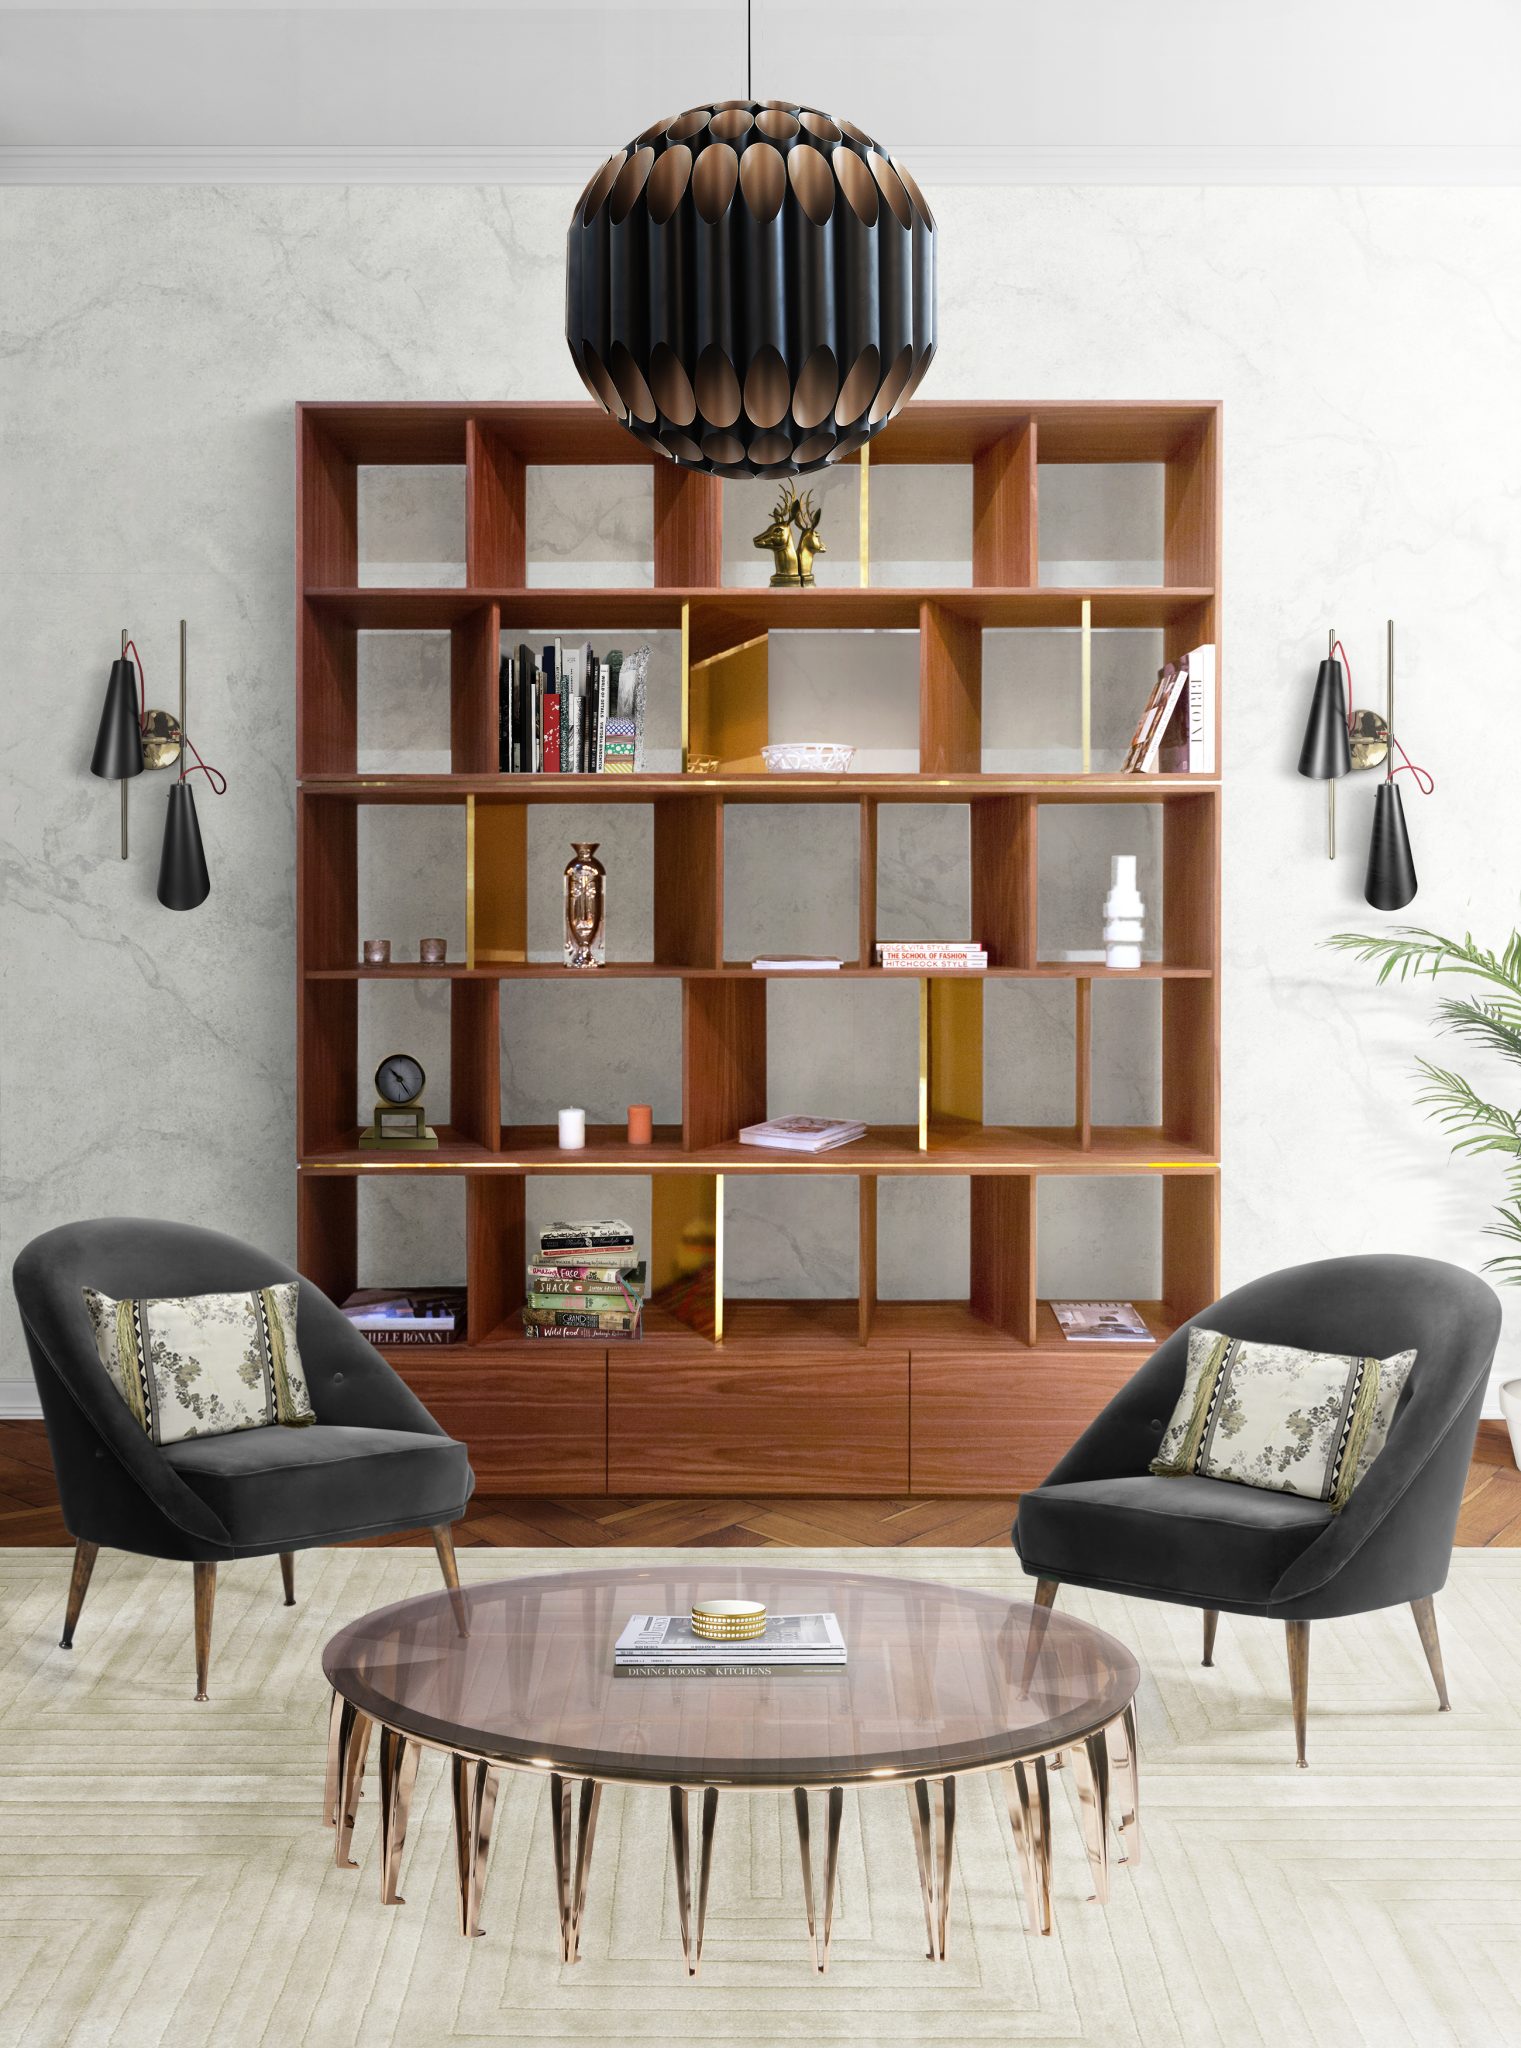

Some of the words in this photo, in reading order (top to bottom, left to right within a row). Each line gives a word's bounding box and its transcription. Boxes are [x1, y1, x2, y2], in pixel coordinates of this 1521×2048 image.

[887, 952, 899, 960] THE
[901, 952, 927, 960] SCHOOL
[929, 952, 937, 960] OF
[939, 952, 967, 960] FASHION
[560, 1268, 581, 1278] Face
[540, 1282, 570, 1293] SHACK
[562, 1314, 587, 1323] GRAND
[544, 1328, 562, 1337] Wild
[628, 1667, 665, 1676] DINING
[668, 1667, 706, 1676] ROOMS
[716, 1667, 772, 1676] KITCHENS
